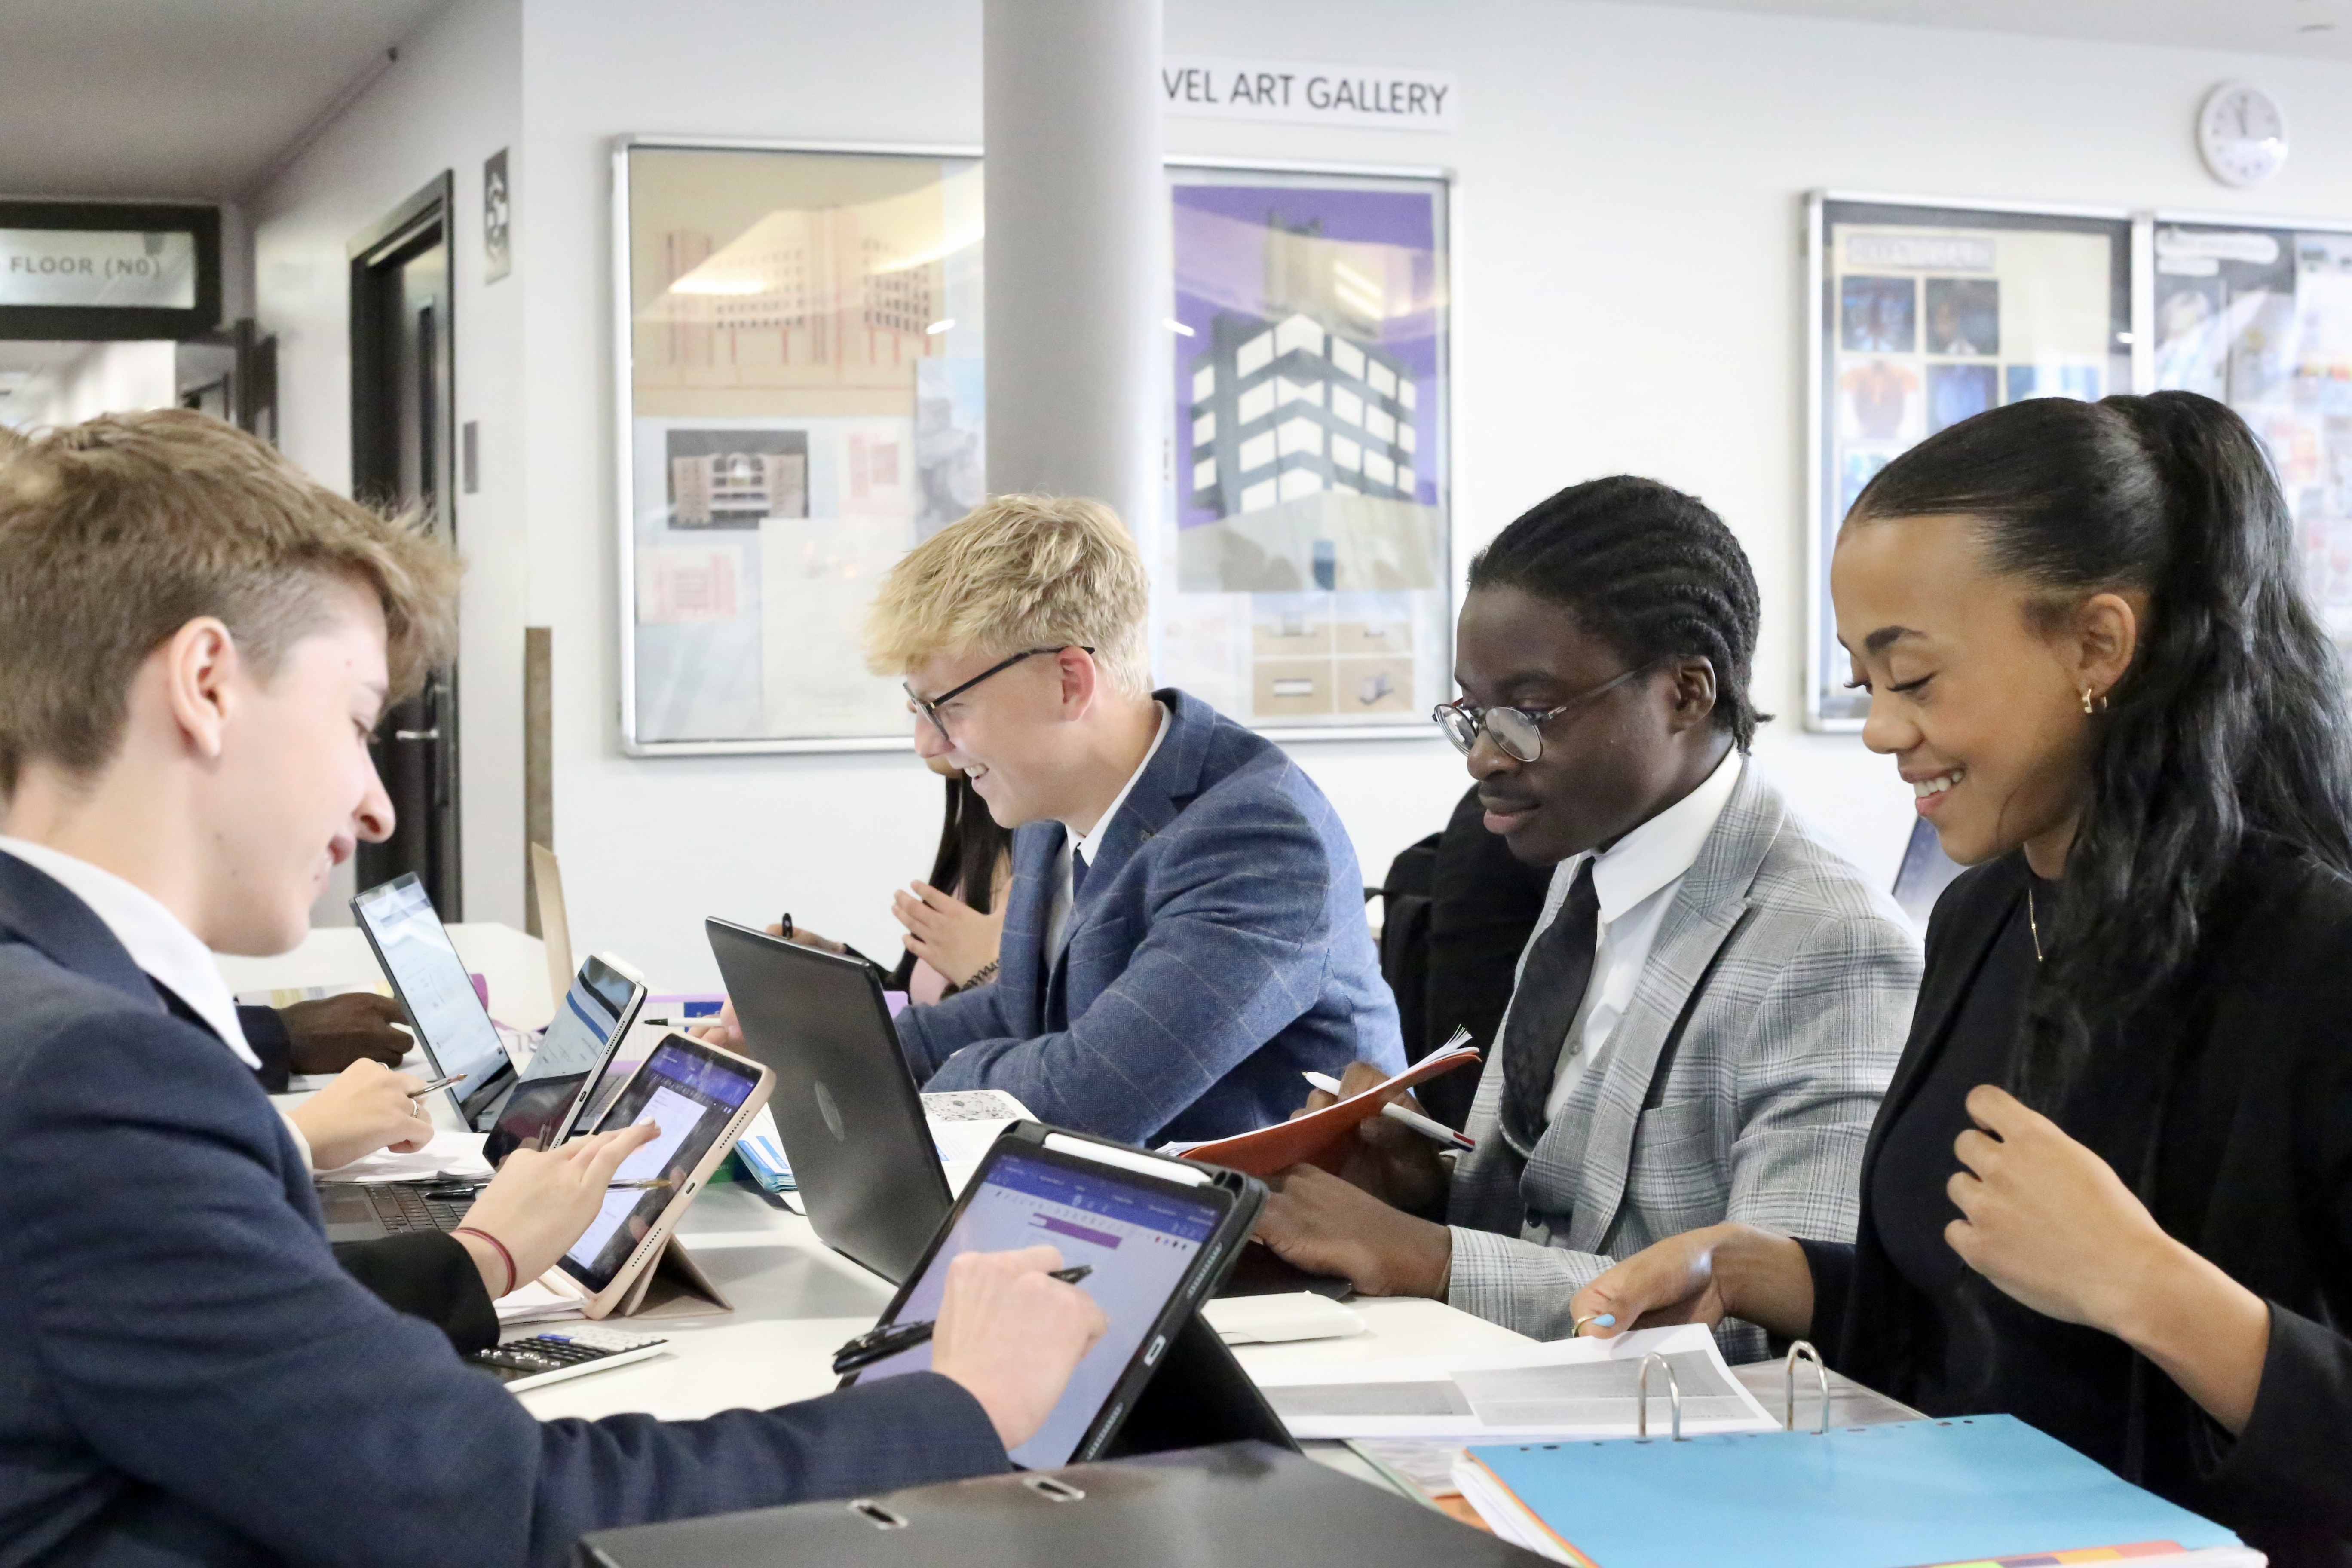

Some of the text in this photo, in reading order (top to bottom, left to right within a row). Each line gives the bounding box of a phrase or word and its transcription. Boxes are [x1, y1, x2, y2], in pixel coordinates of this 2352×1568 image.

[1163, 67, 1449, 116] VEL ART GALLERY
[10, 257, 93, 275] FLOOR
